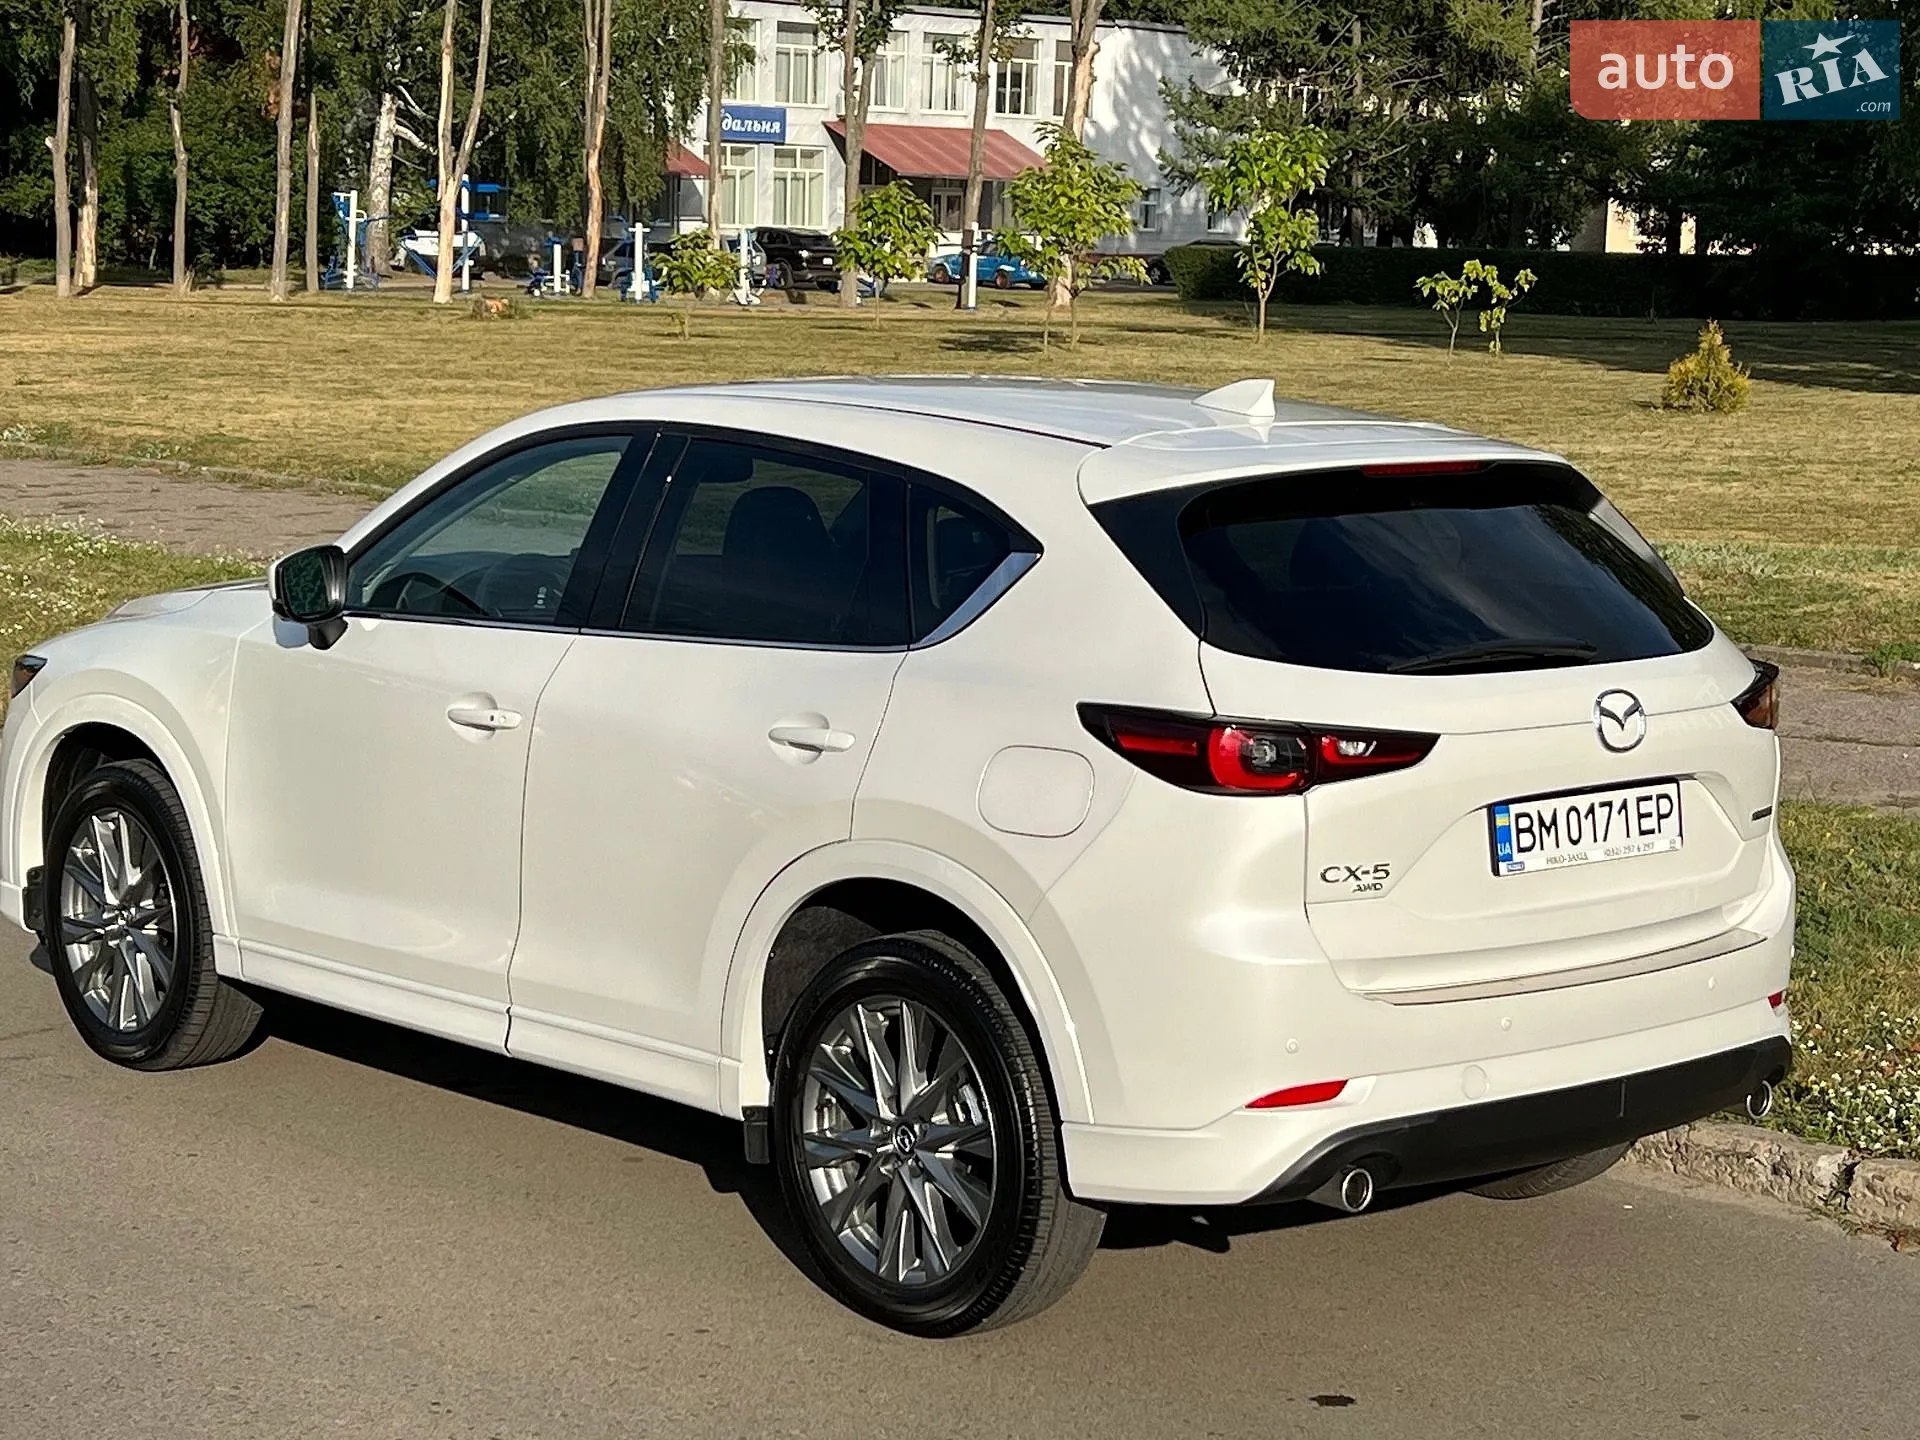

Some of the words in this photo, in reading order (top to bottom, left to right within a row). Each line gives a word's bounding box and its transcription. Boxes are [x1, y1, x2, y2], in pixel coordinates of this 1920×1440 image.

[720, 108, 781, 133] дальня
[1497, 843, 1512, 856] UA
[1320, 863, 1391, 884] CX-5
[1352, 882, 1383, 893] AWD
